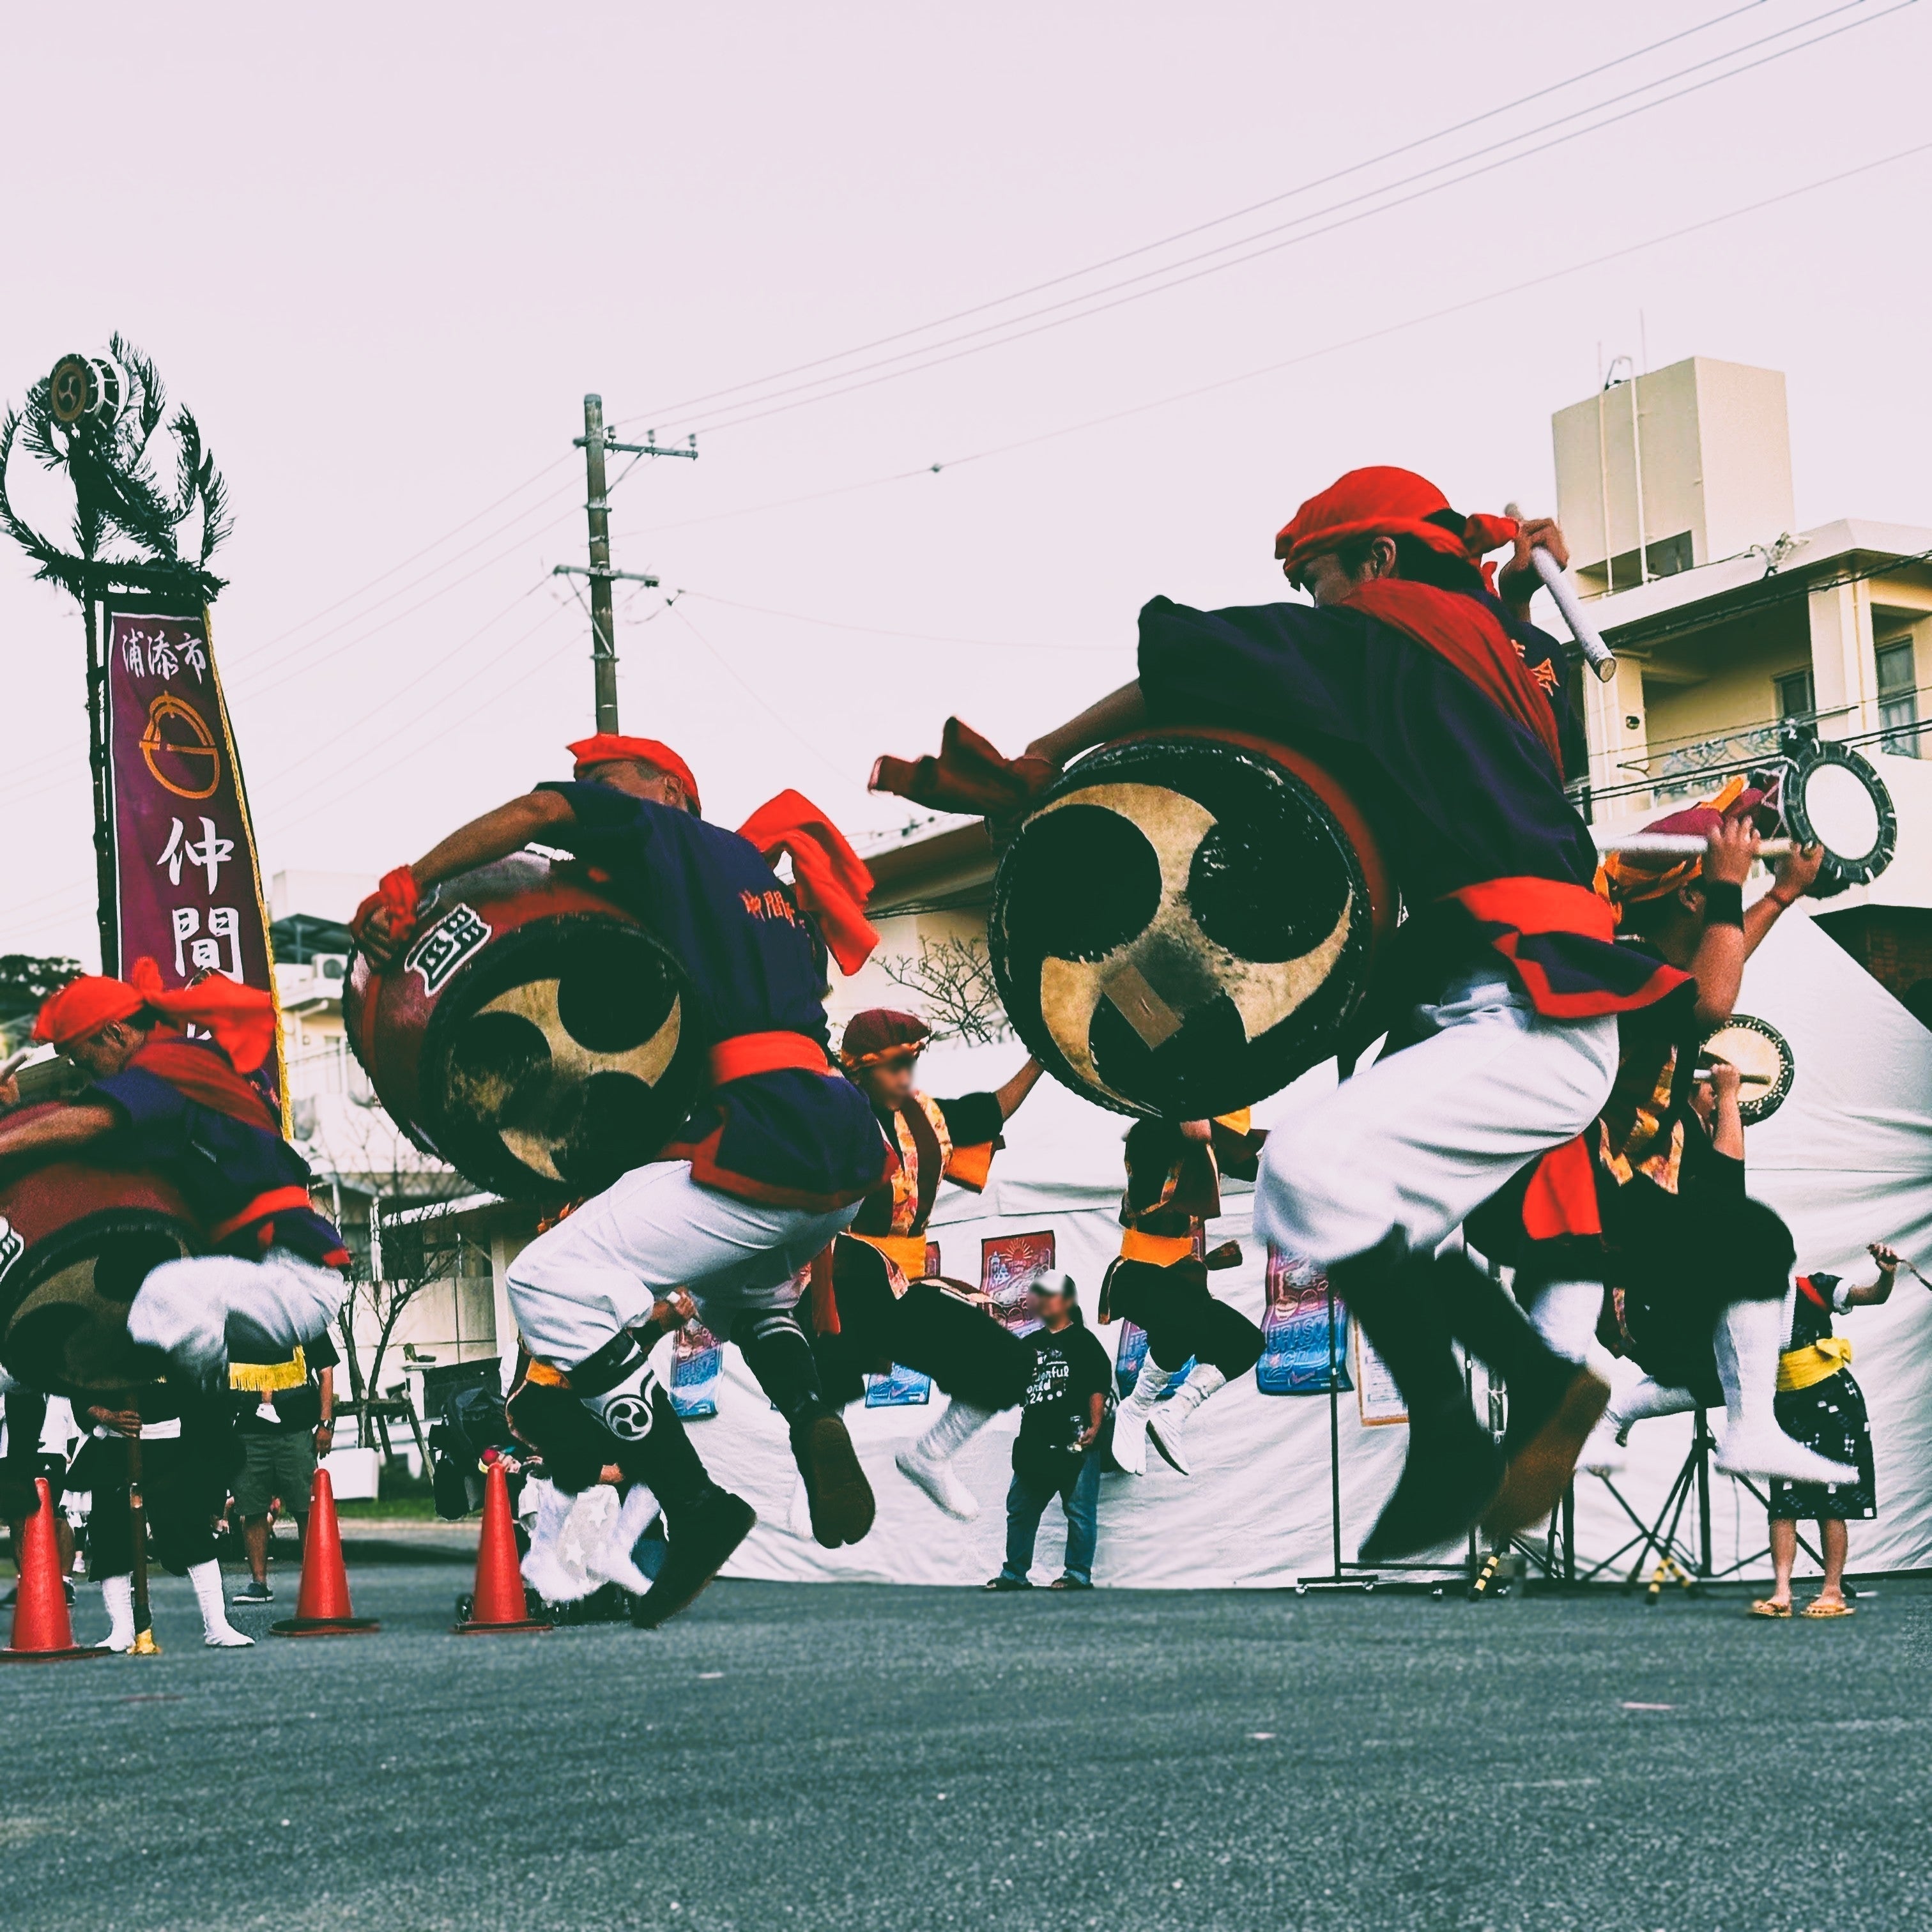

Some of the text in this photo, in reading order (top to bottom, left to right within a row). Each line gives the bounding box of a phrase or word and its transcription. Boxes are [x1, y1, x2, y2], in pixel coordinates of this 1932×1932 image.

[122, 627, 206, 684] 浦添市
[157, 816, 244, 991] 仲間
